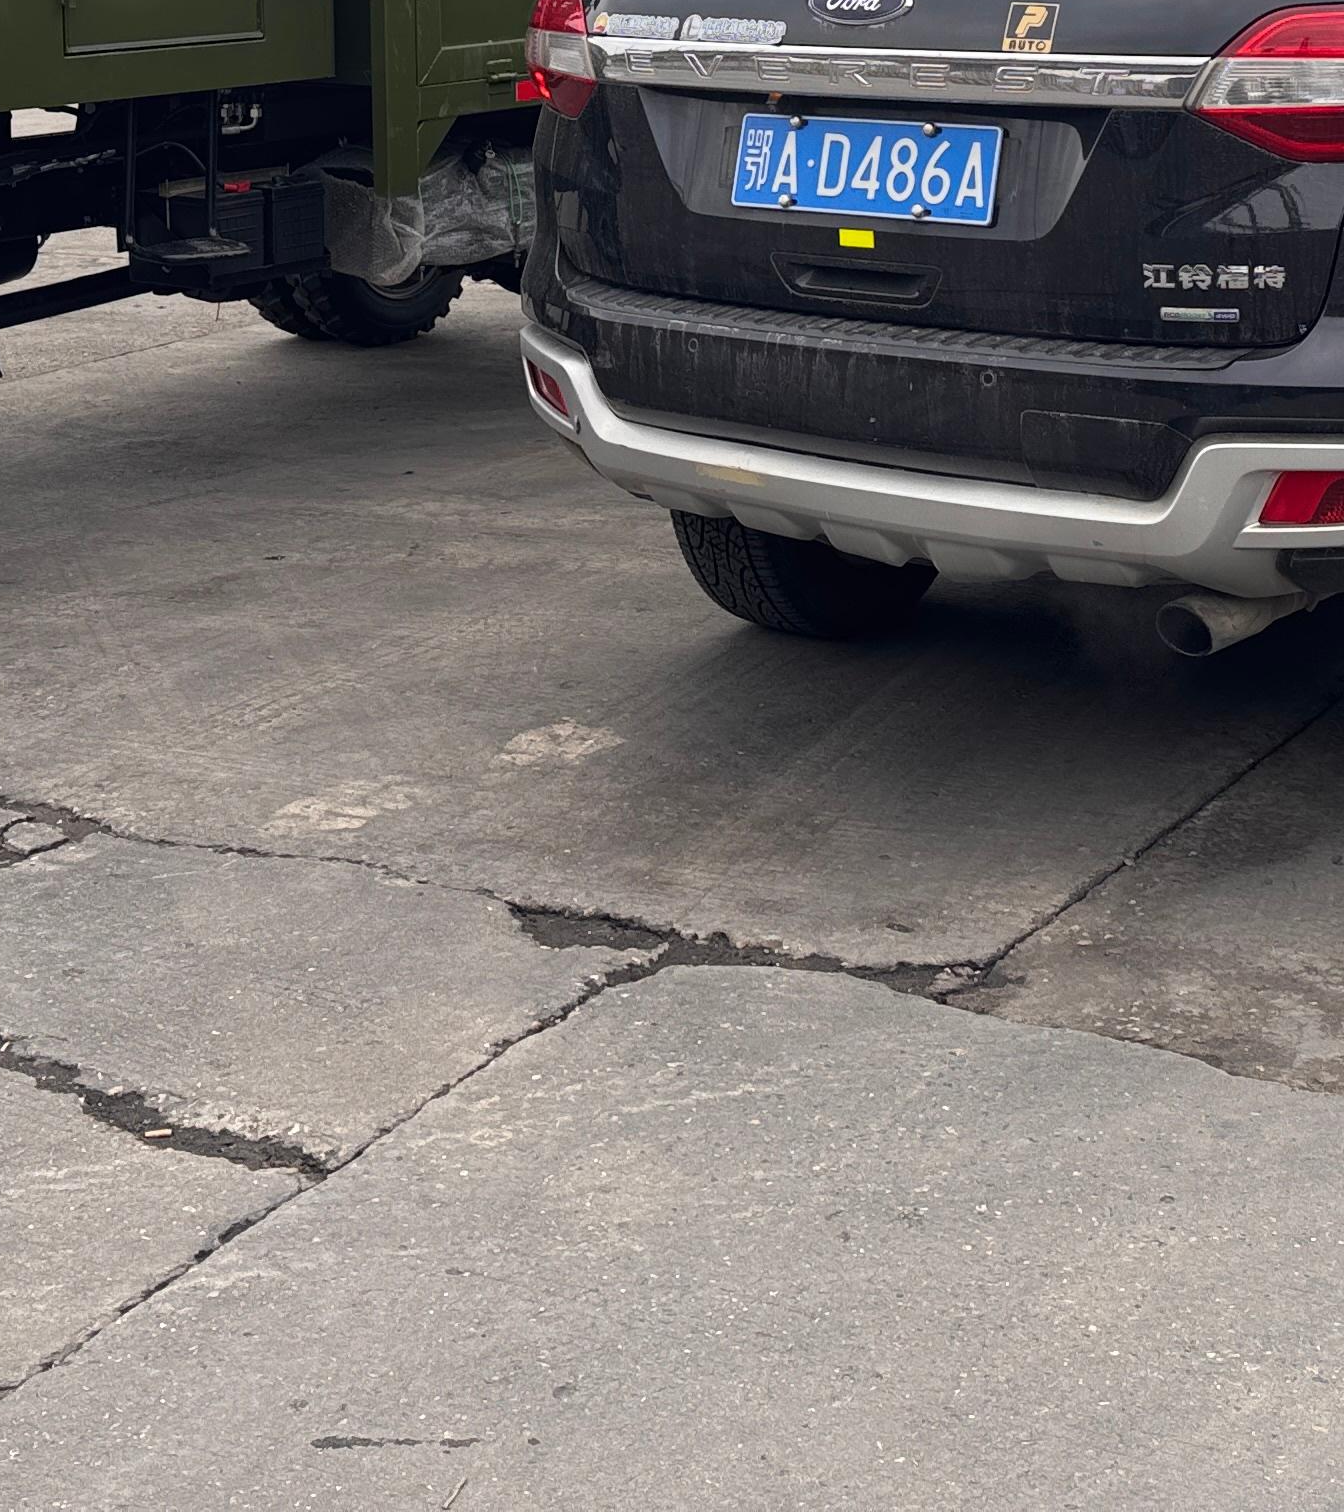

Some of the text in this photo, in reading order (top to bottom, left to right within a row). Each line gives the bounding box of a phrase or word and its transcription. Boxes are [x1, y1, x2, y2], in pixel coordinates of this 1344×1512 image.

[1008, 39, 1047, 52] AUTO
[625, 48, 1131, 96] EVEREST
[743, 128, 985, 209] 鄂A·D486A
[1142, 263, 1287, 290] 江铃福特
